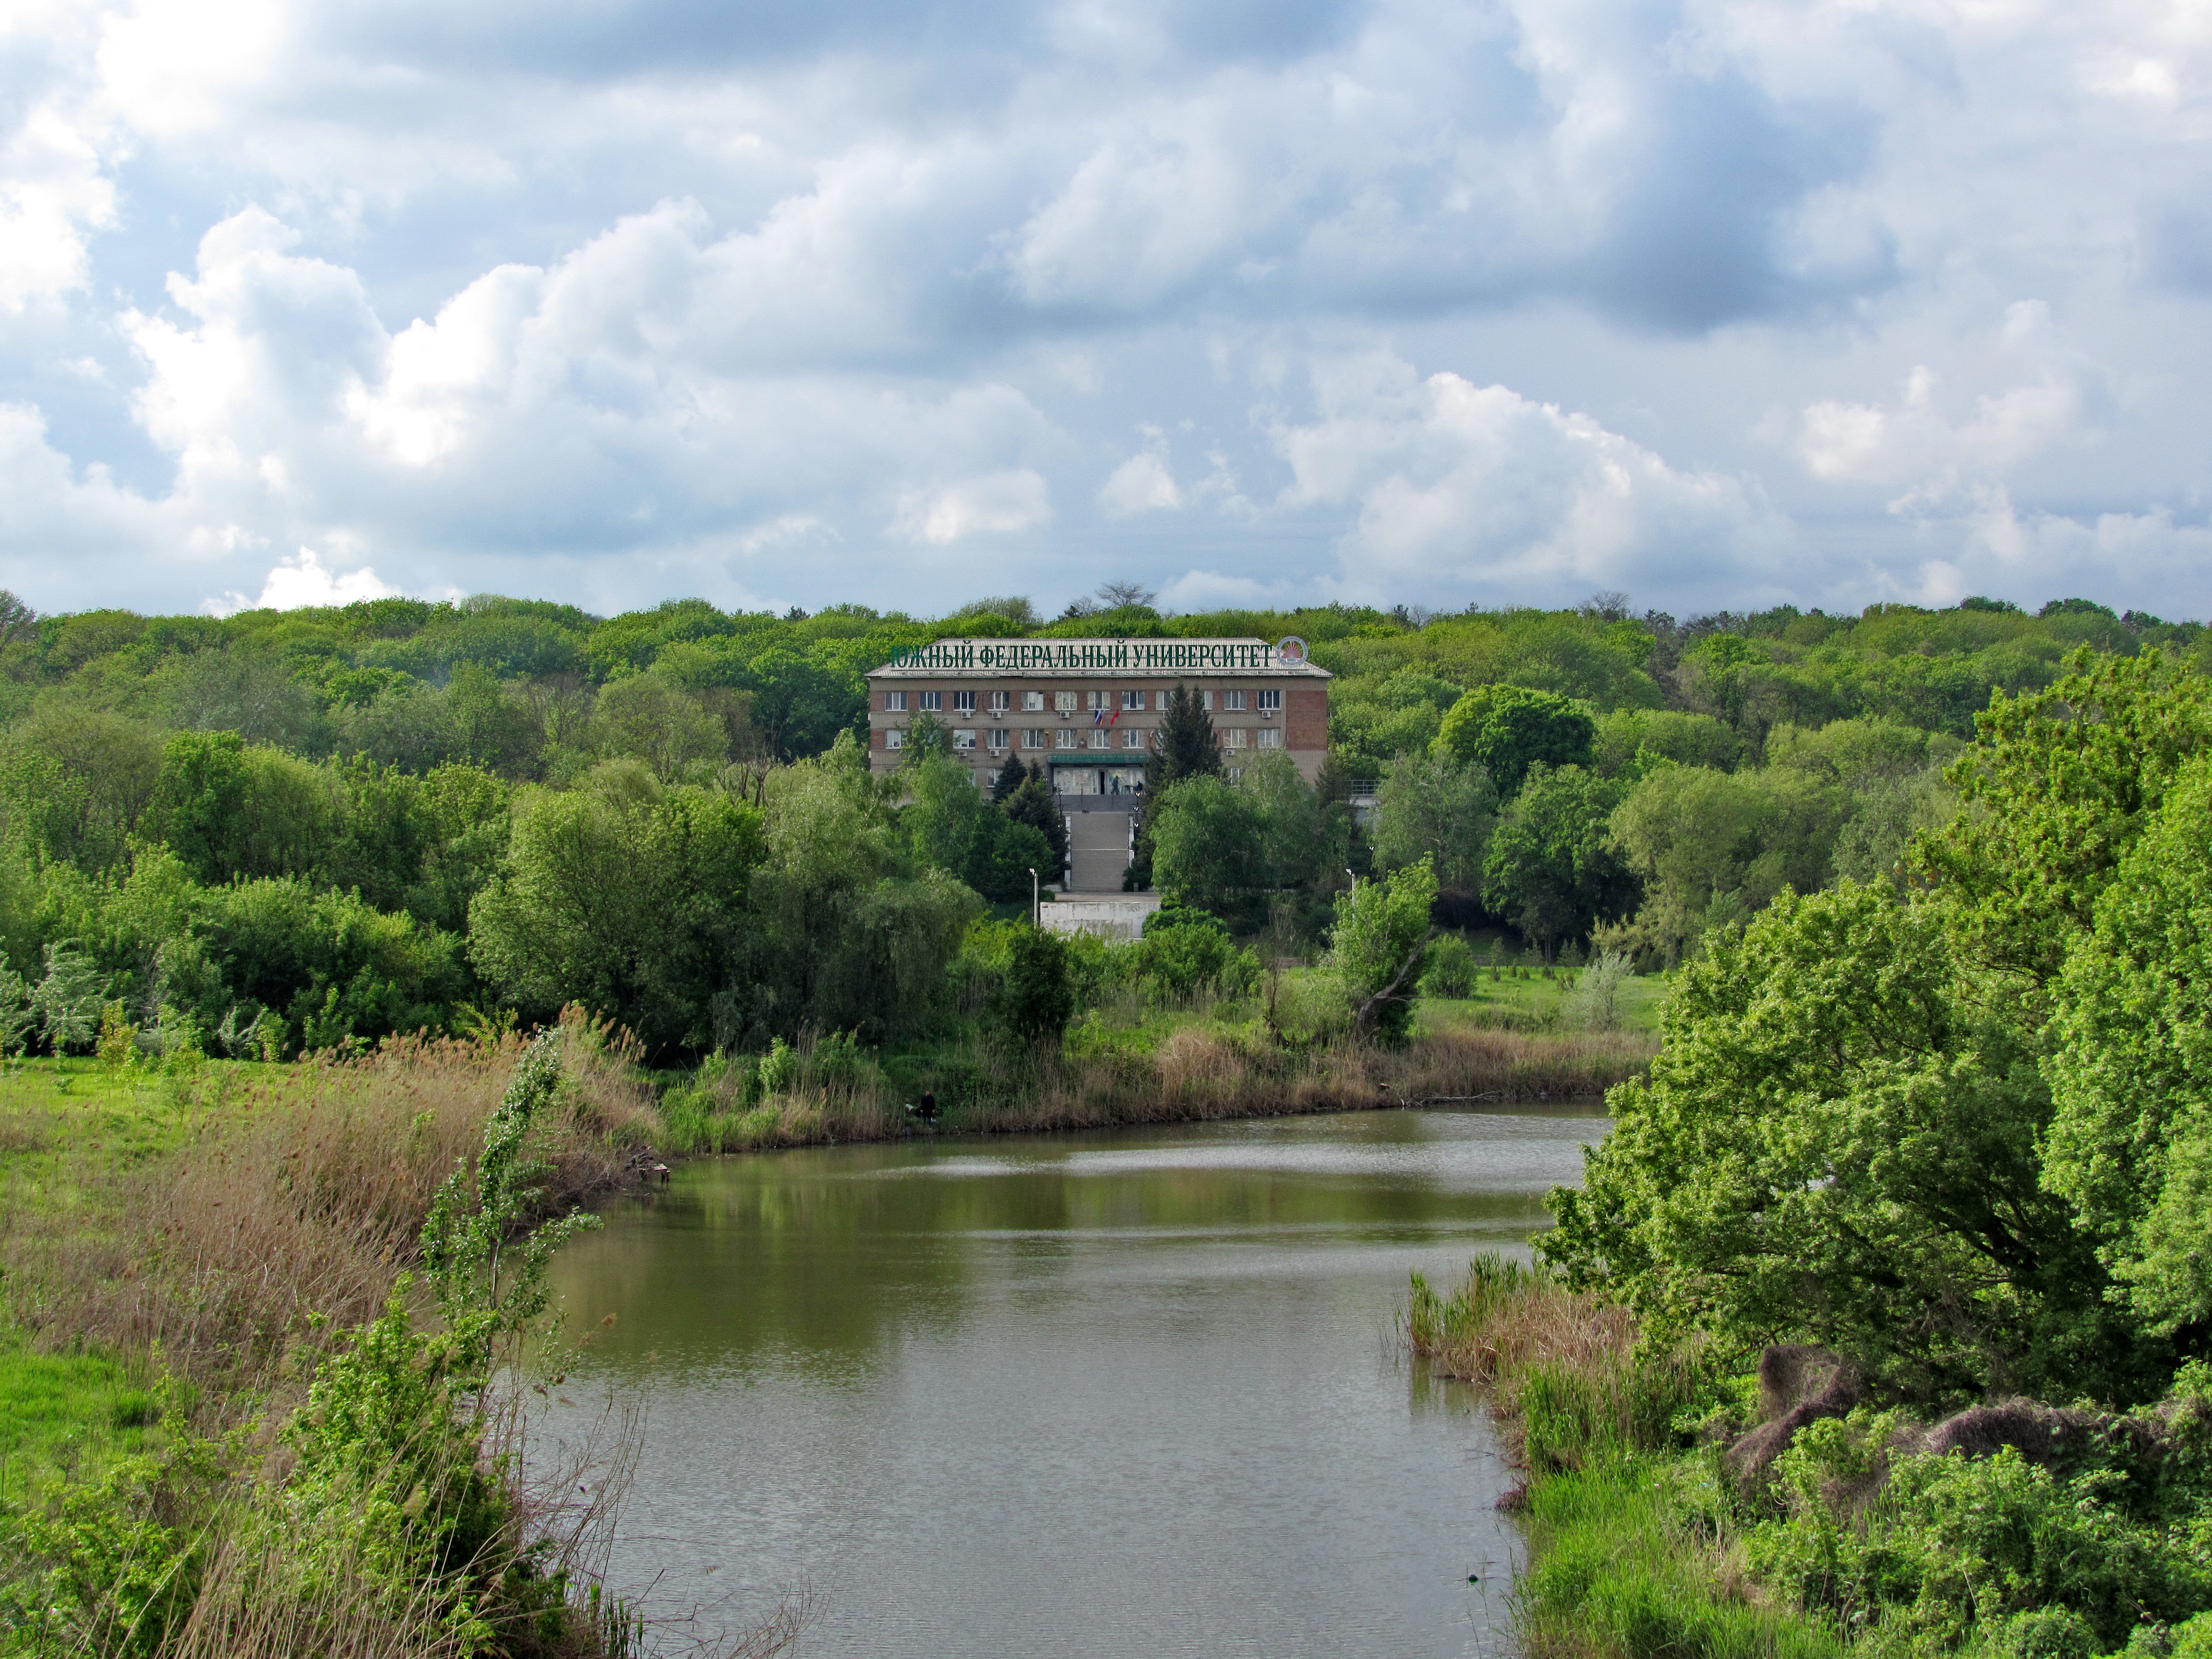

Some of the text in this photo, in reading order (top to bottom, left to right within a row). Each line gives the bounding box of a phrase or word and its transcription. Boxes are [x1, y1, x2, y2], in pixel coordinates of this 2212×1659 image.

[890, 640, 974, 667] ЮЖНЫЙ
[980, 640, 1127, 670] ФЕДЕРАЛЬНЫЙ
[1133, 645, 1272, 667] УНИВЕРСИТЕТ
